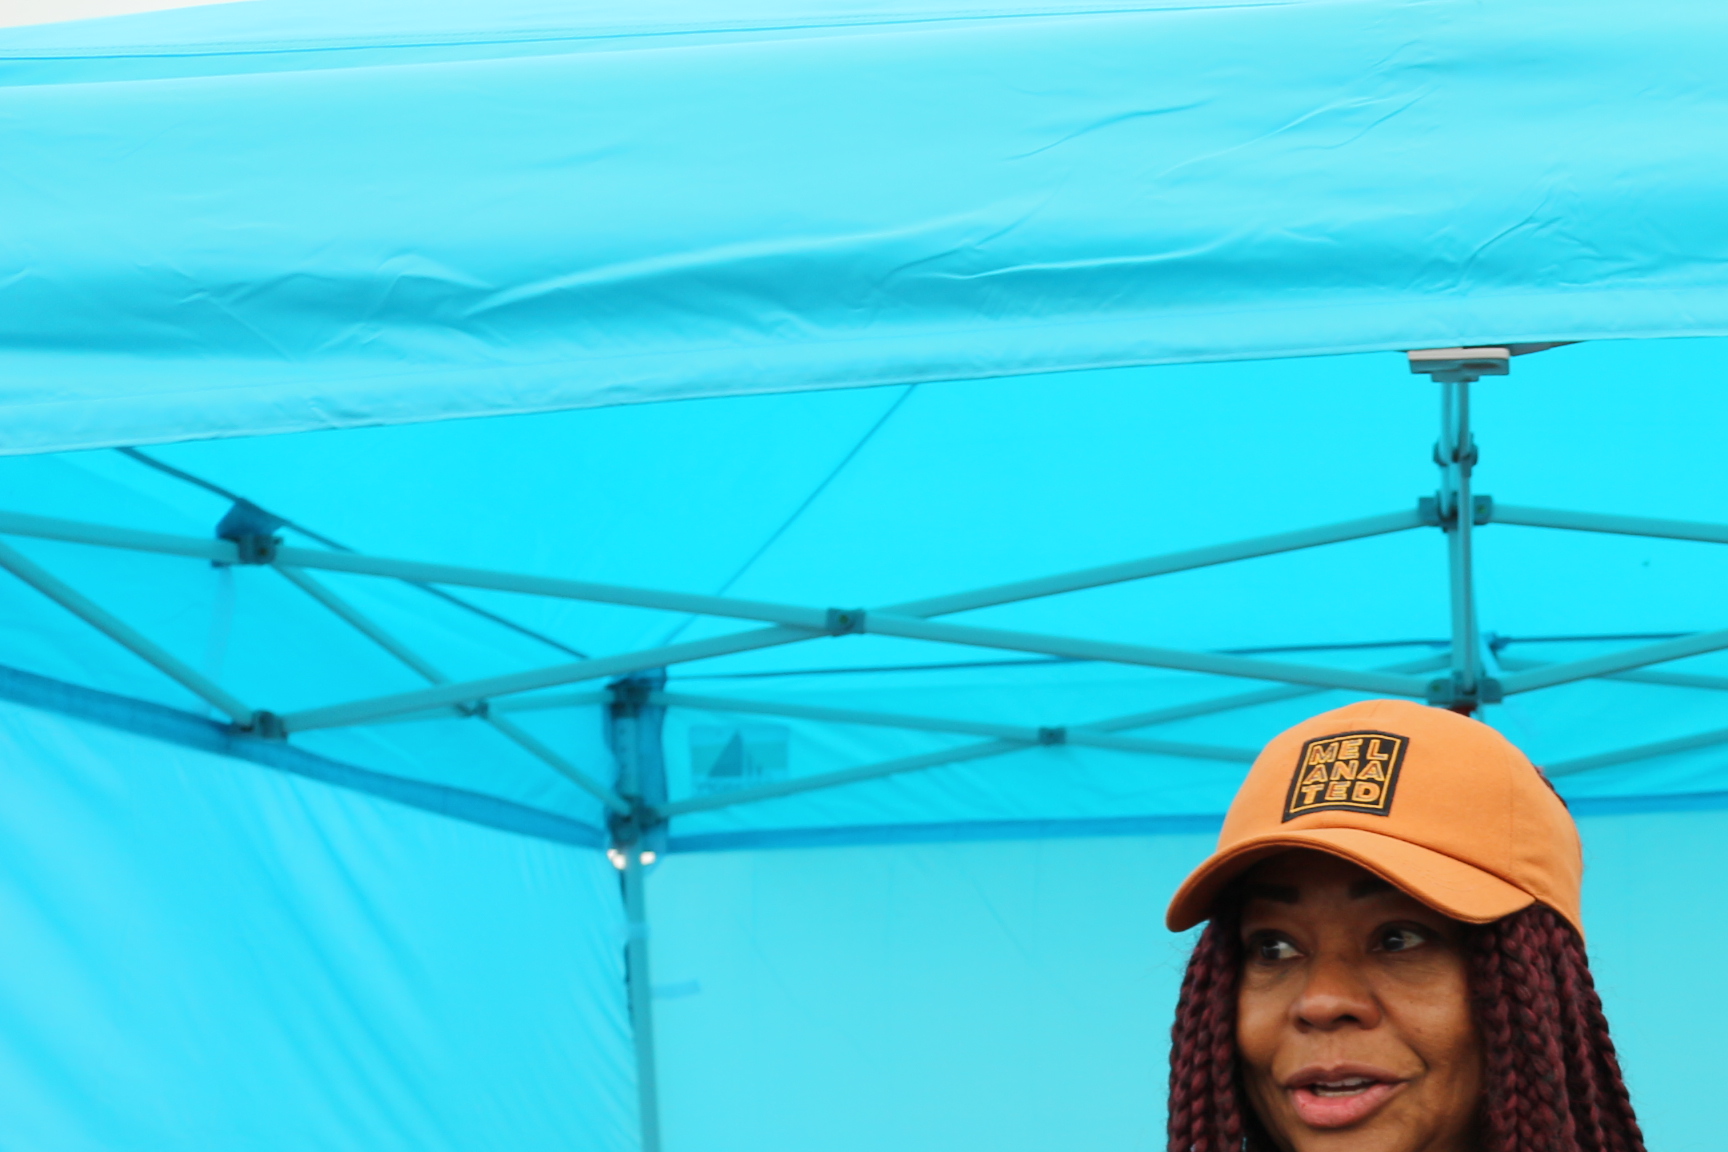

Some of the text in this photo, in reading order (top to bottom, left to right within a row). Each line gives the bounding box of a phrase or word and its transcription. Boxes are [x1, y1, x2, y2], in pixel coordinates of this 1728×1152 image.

[1309, 738, 1389, 765] MEL
[1302, 760, 1385, 785] ANA
[1301, 780, 1381, 805] TED
